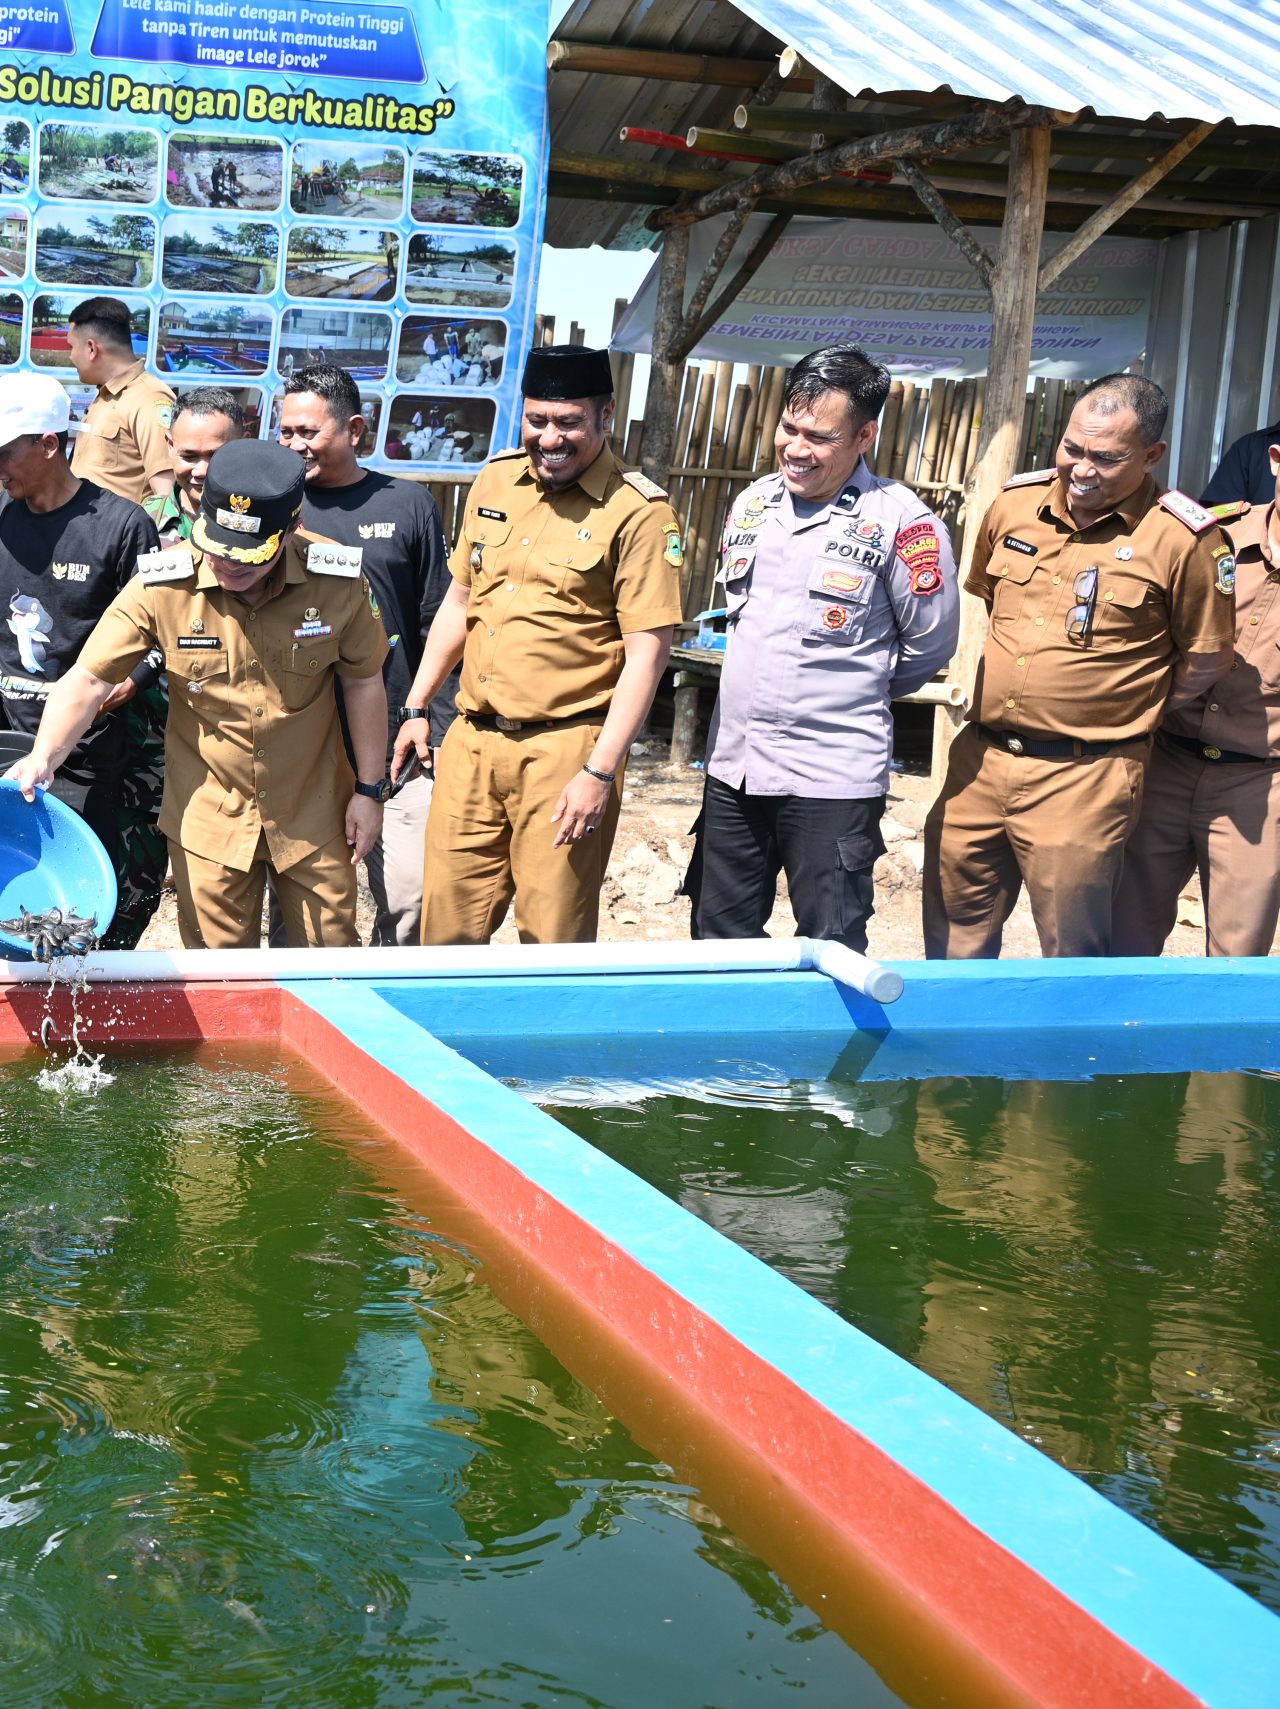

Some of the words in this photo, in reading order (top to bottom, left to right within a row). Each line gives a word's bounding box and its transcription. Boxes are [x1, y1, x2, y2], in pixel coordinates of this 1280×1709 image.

[154, 0, 191, 15] kami
[194, 0, 237, 18] hadir
[239, 3, 297, 23] dengan
[300, 9, 355, 27] Protein
[358, 14, 404, 34] Tinggi
[142, 18, 187, 36] tanpa
[189, 22, 229, 39] Tiren
[232, 27, 278, 43] untuk
[280, 31, 378, 51] memutuskan
[196, 44, 244, 65] image
[247, 48, 277, 63] Lele
[109, 76, 239, 122] Pangan
[825, 540, 881, 568] POLRI
[900, 538, 936, 553] POLRES
[67, 572, 86, 581] DES
[68, 563, 90, 574] BUM
